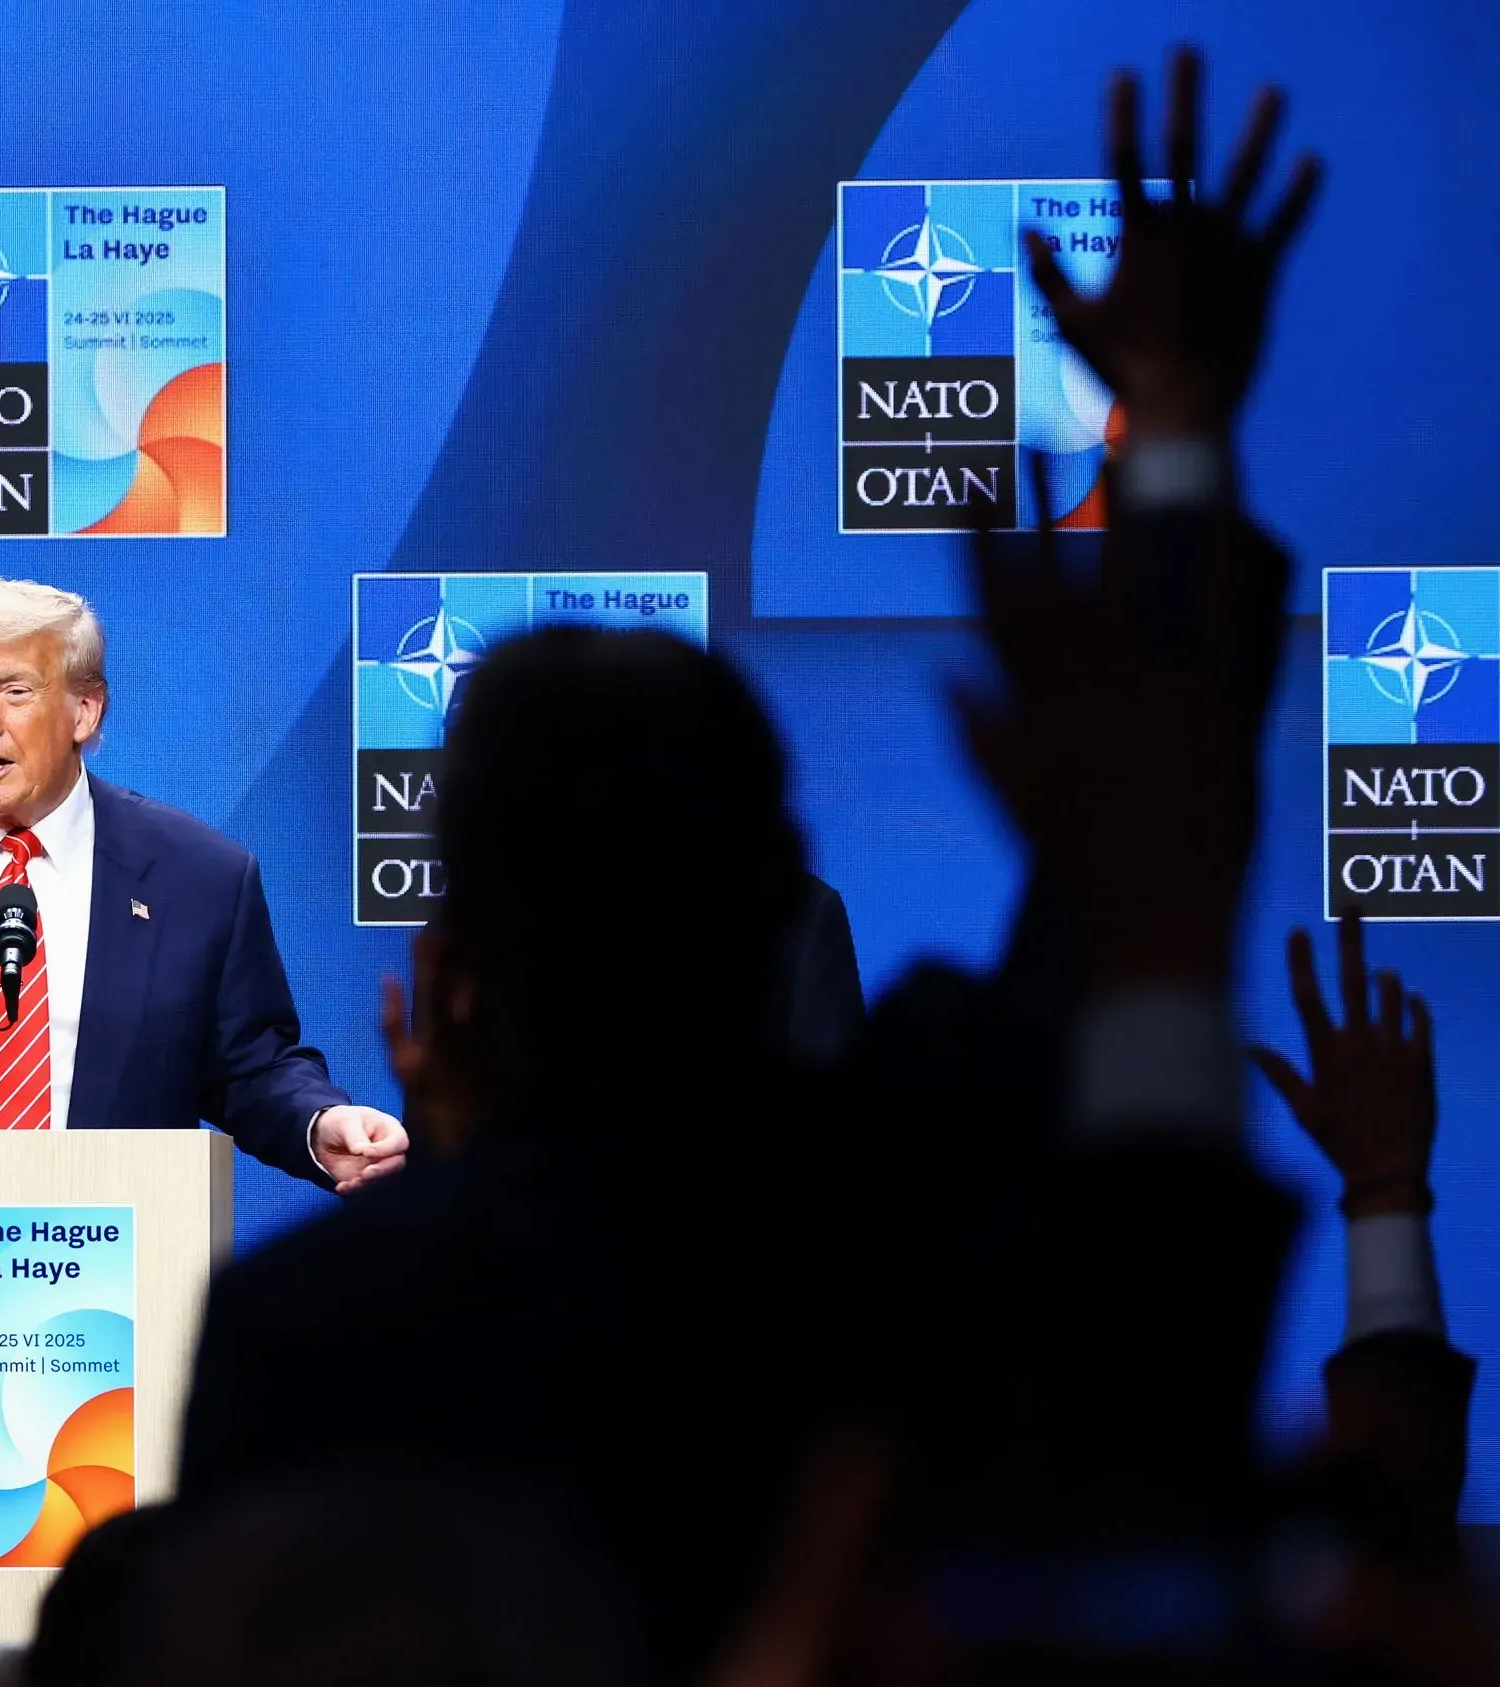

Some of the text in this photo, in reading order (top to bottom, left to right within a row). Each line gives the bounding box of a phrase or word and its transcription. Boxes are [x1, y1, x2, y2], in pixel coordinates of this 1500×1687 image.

[64, 205, 207, 231] The Hague
[1031, 198, 1080, 217] The
[63, 240, 170, 266] La Haye
[1071, 232, 1119, 259] Hay
[64, 312, 175, 325] 24-25 VI 2025
[63, 335, 126, 349] Summit
[140, 335, 208, 349] Sommet
[857, 380, 999, 419] NATO
[857, 467, 1000, 506] OTAN
[546, 590, 689, 616] The Hague
[372, 772, 438, 811] NA
[1342, 766, 1485, 807] NATO
[371, 858, 447, 898] OT
[1342, 854, 1486, 893] OTAN
[31, 1221, 120, 1249] Hague
[12, 1258, 80, 1285] Haye
[23, 1334, 40, 1348] VI
[44, 1334, 85, 1348] 2025
[50, 1358, 120, 1373] Sommet
